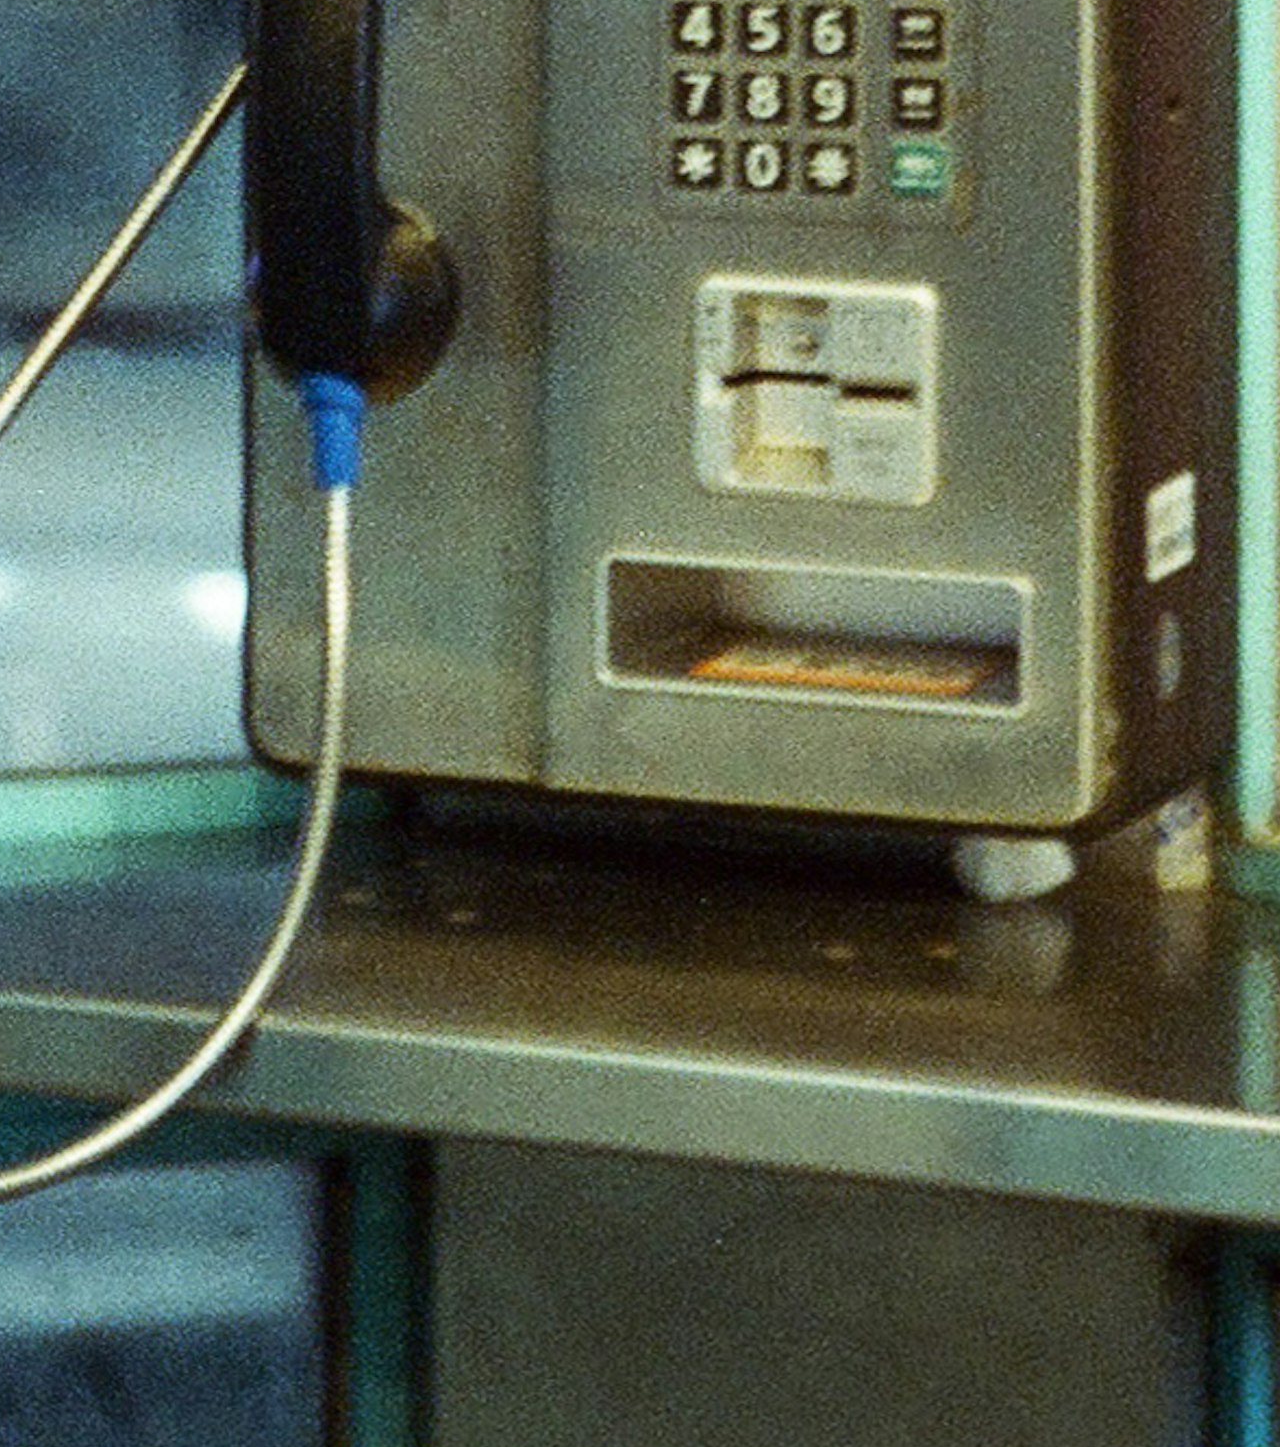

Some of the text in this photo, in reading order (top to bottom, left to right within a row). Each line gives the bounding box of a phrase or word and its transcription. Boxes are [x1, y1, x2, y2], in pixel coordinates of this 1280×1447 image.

[680, 3, 713, 47] 4
[749, 4, 780, 52] 5
[813, 7, 845, 54] 6
[684, 72, 713, 118] 7
[747, 74, 780, 119] 8
[813, 76, 846, 122] 9
[745, 142, 780, 188] 0
